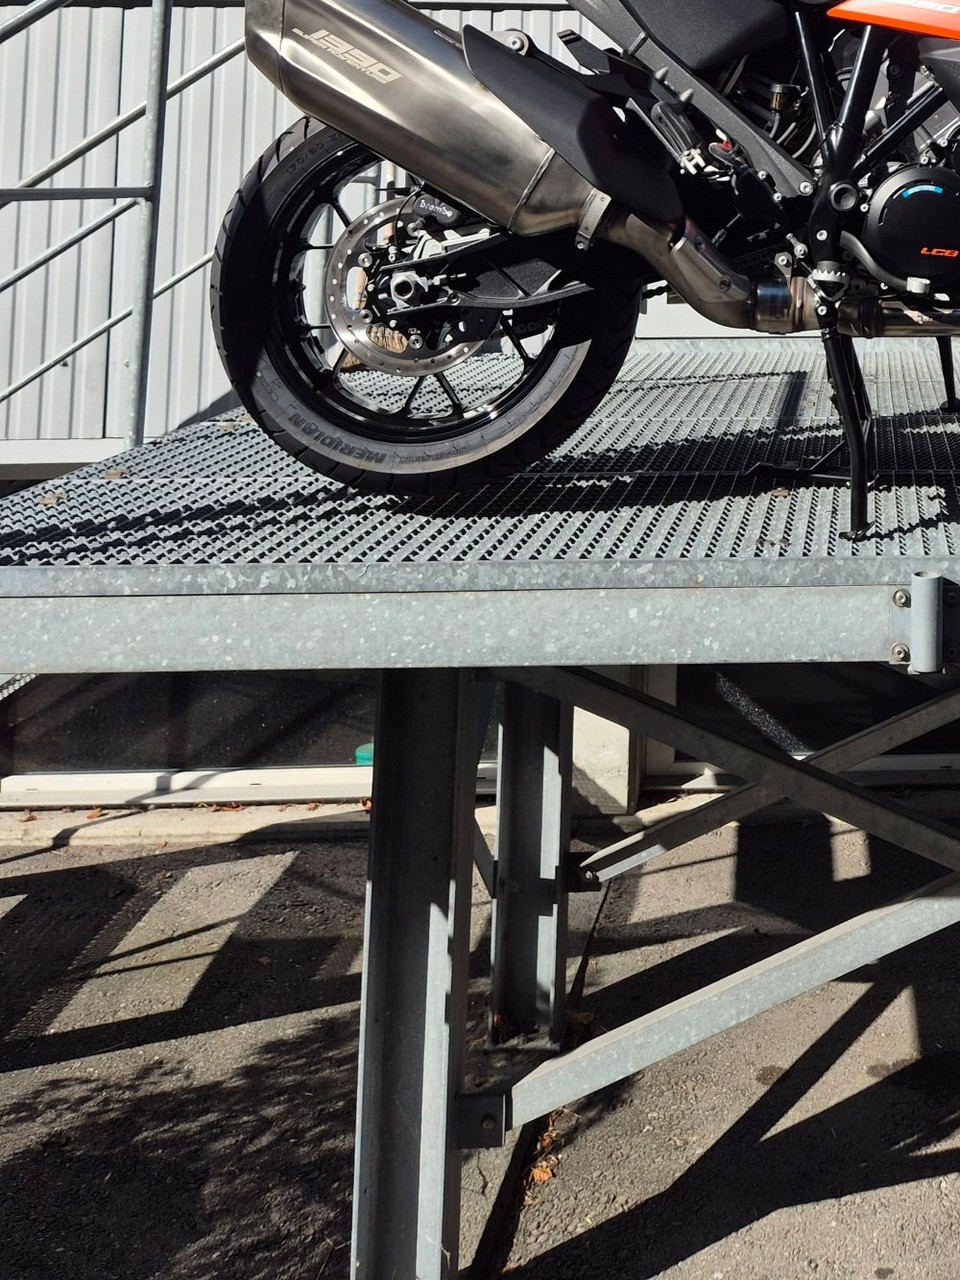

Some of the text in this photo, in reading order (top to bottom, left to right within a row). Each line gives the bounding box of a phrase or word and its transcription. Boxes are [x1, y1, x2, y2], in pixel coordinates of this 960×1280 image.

[308, 29, 403, 81] 1390
[420, 200, 453, 218] brembo
[921, 247, 959, 257] LC8
[288, 413, 387, 464] MERIDIAN
